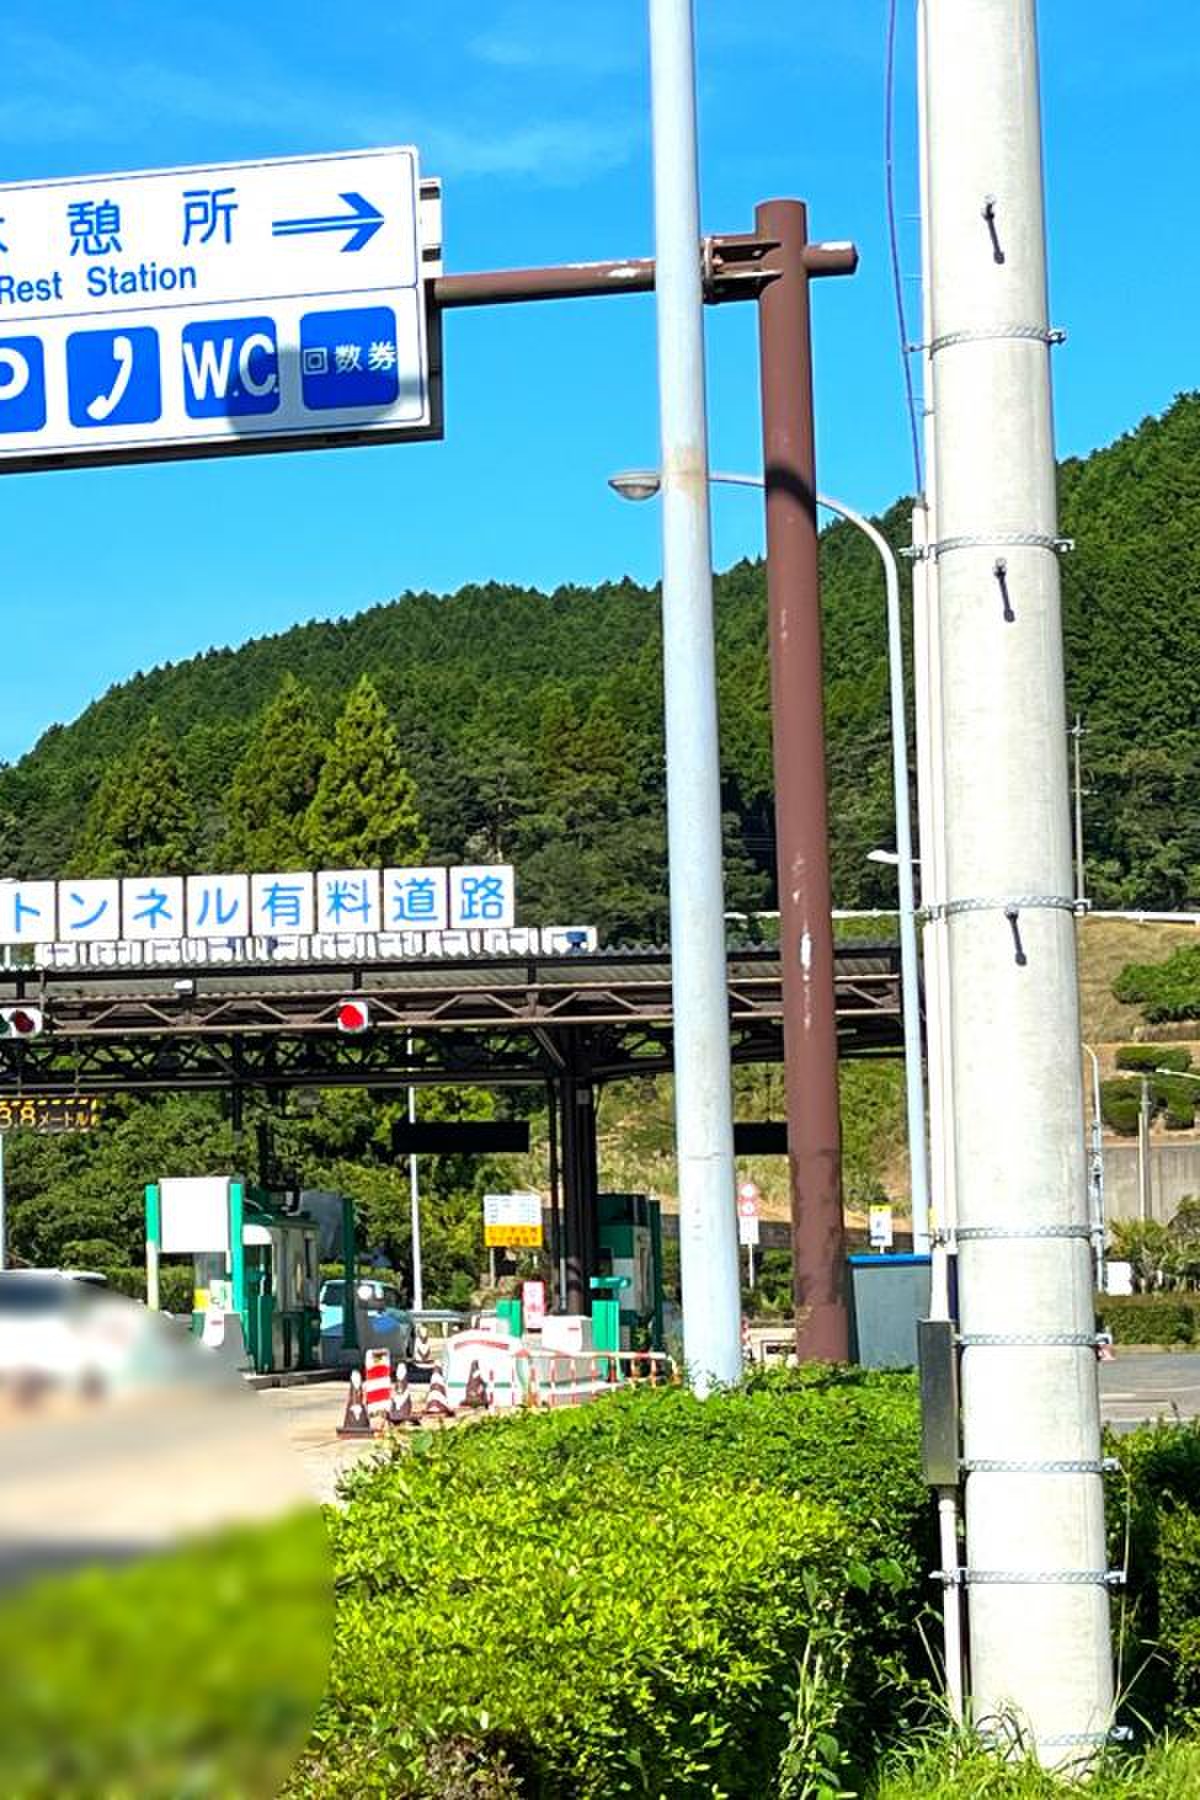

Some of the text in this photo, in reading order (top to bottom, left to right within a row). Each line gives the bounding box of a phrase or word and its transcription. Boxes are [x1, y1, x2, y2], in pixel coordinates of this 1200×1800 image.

[86, 262, 197, 297] Station
[303, 341, 397, 375] 回数券
